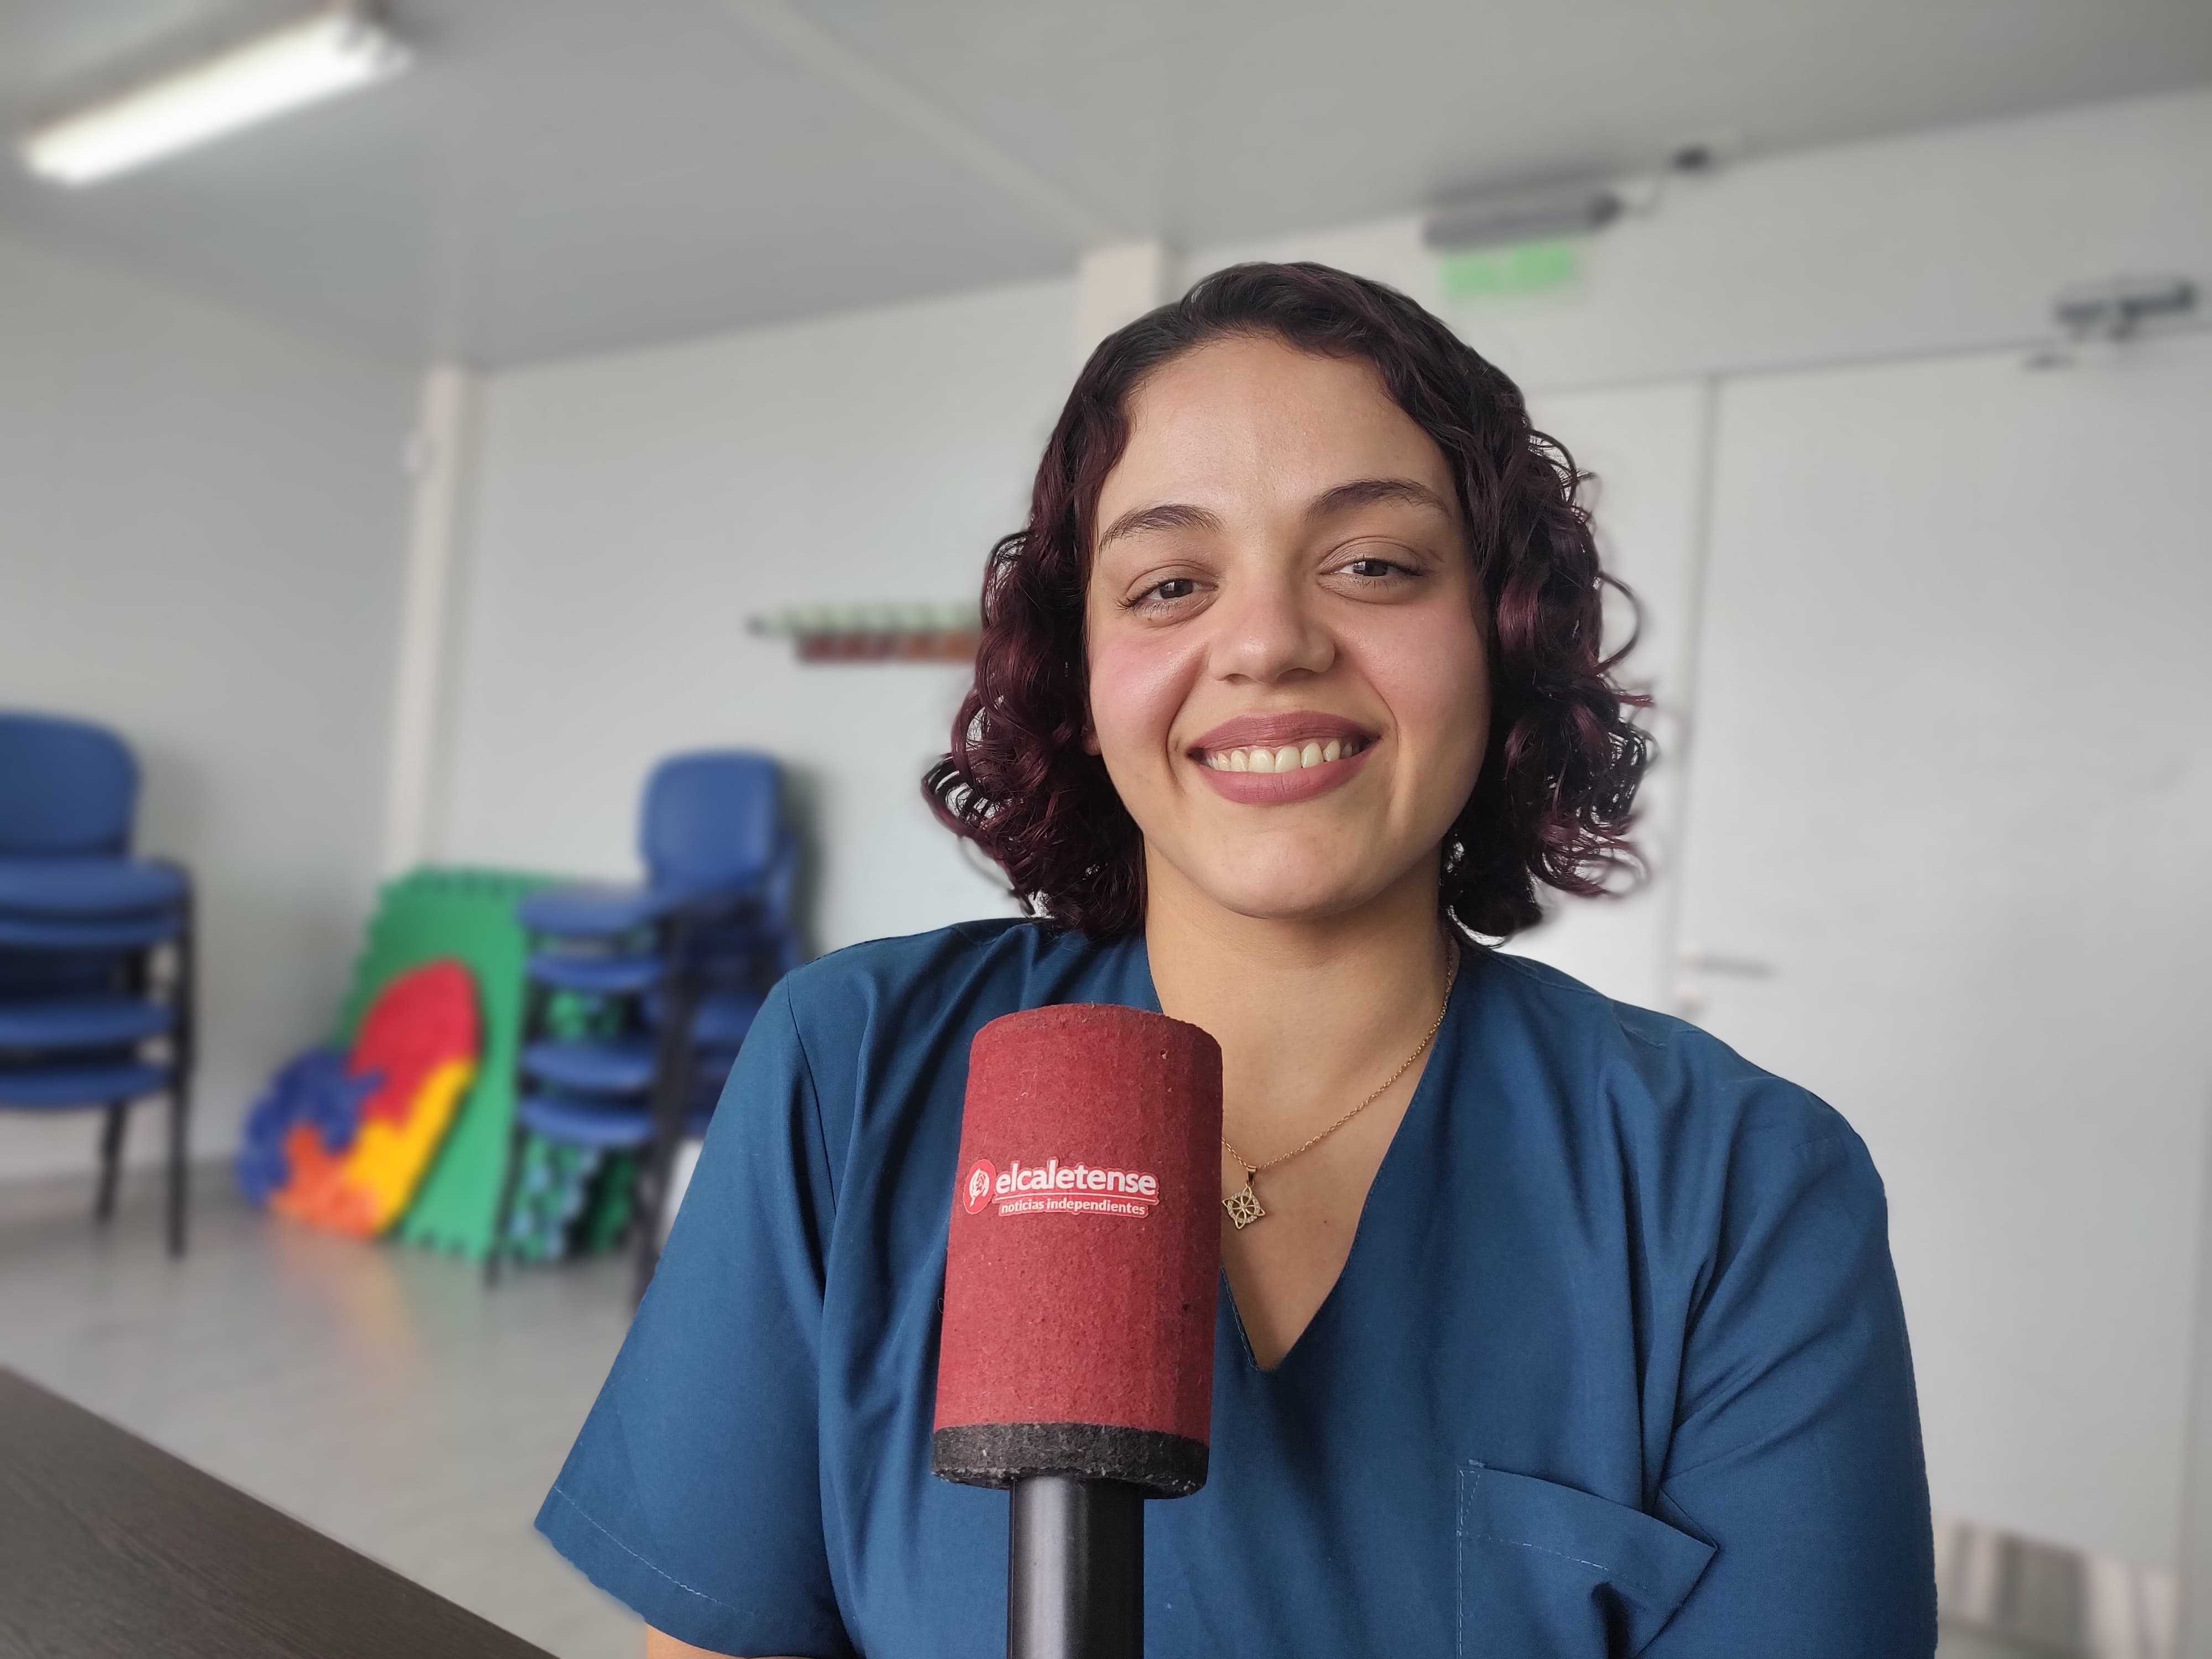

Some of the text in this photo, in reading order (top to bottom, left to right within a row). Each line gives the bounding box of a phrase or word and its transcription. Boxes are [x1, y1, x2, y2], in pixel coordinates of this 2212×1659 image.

[995, 1159, 1157, 1195] elcaletense
[1001, 1198, 1146, 1215] noticias independientes
